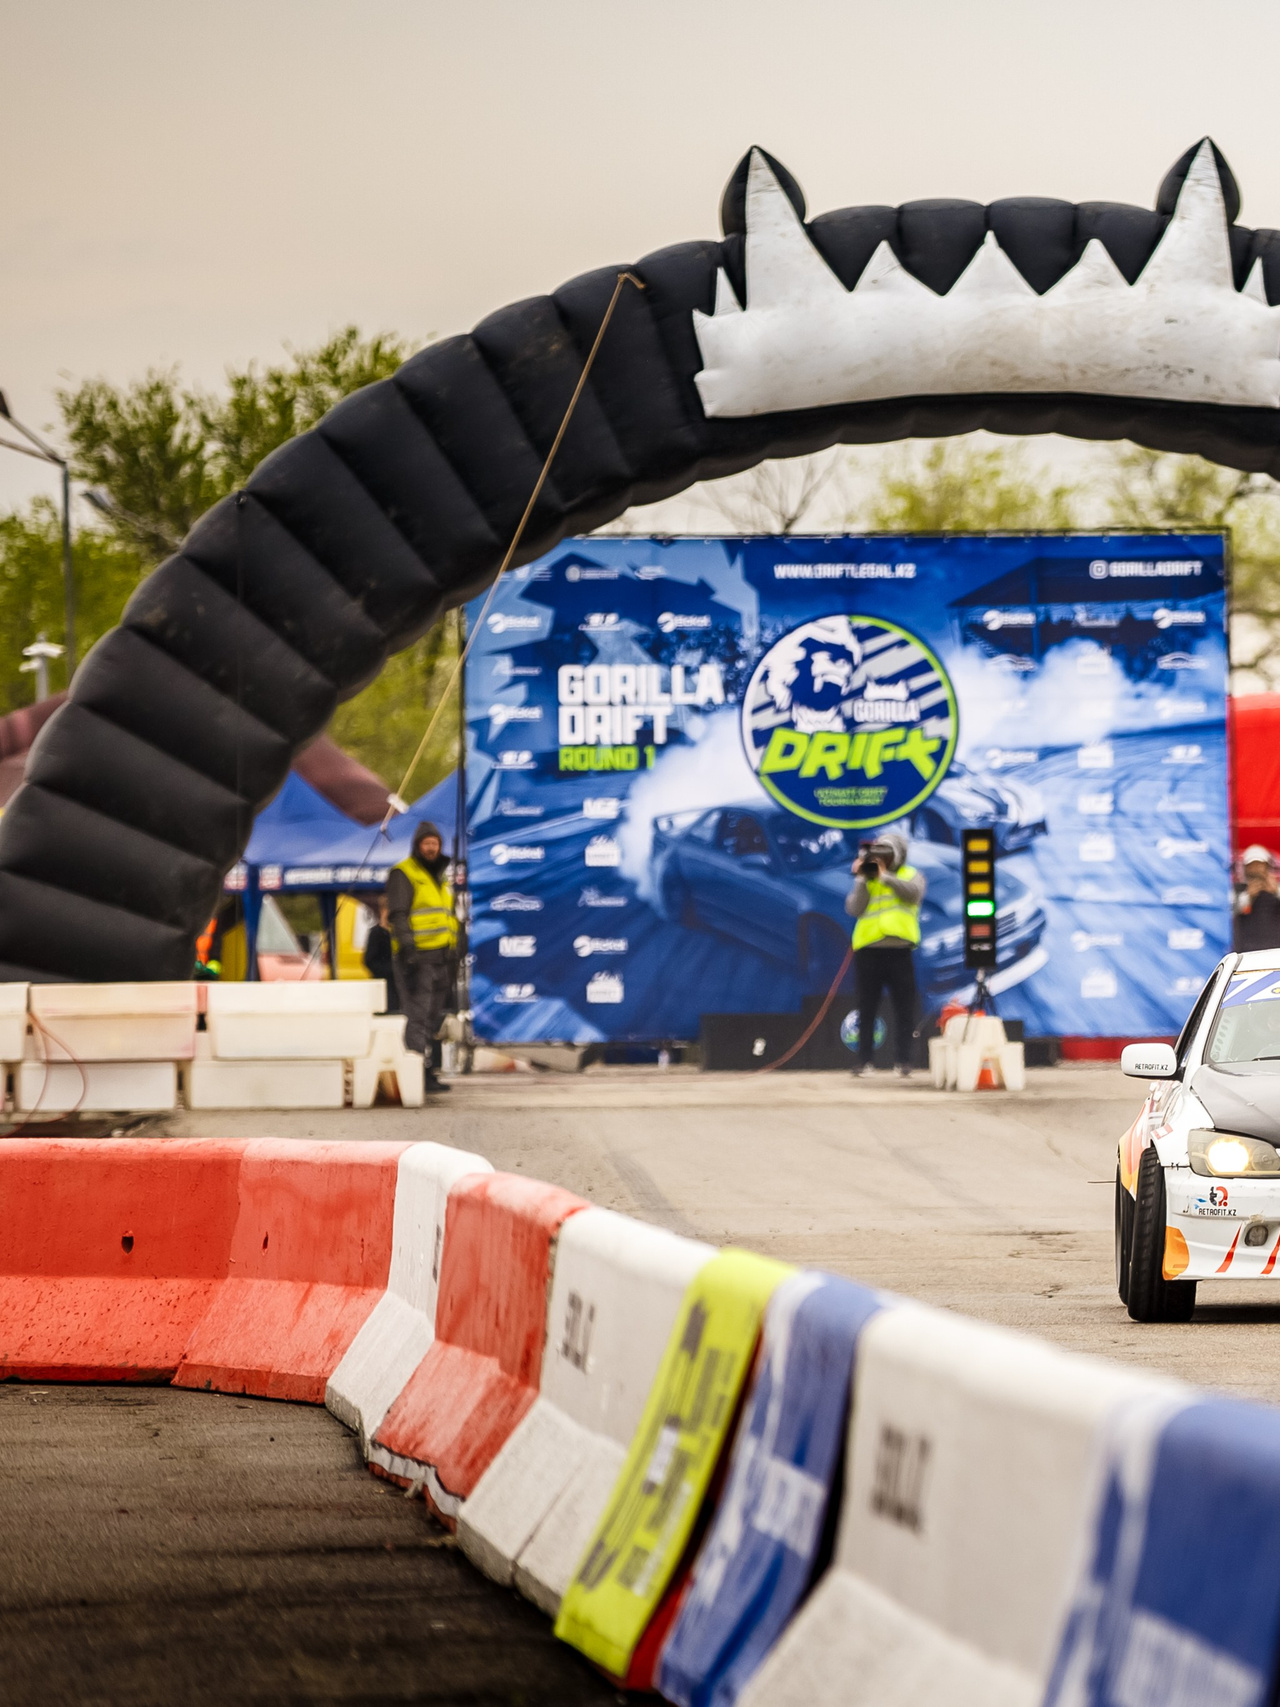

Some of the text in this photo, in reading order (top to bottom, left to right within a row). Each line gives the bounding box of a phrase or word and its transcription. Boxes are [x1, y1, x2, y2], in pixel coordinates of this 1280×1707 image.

[558, 663, 726, 705] GORILLA
[853, 699, 920, 722] GORILLA
[558, 705, 674, 745] DRIFT
[558, 745, 640, 771] ROUND
[643, 745, 655, 769] 1
[1134, 1063, 1169, 1071] RETROFIT.KZ
[1198, 1208, 1237, 1216] RETROFIT.KZ
